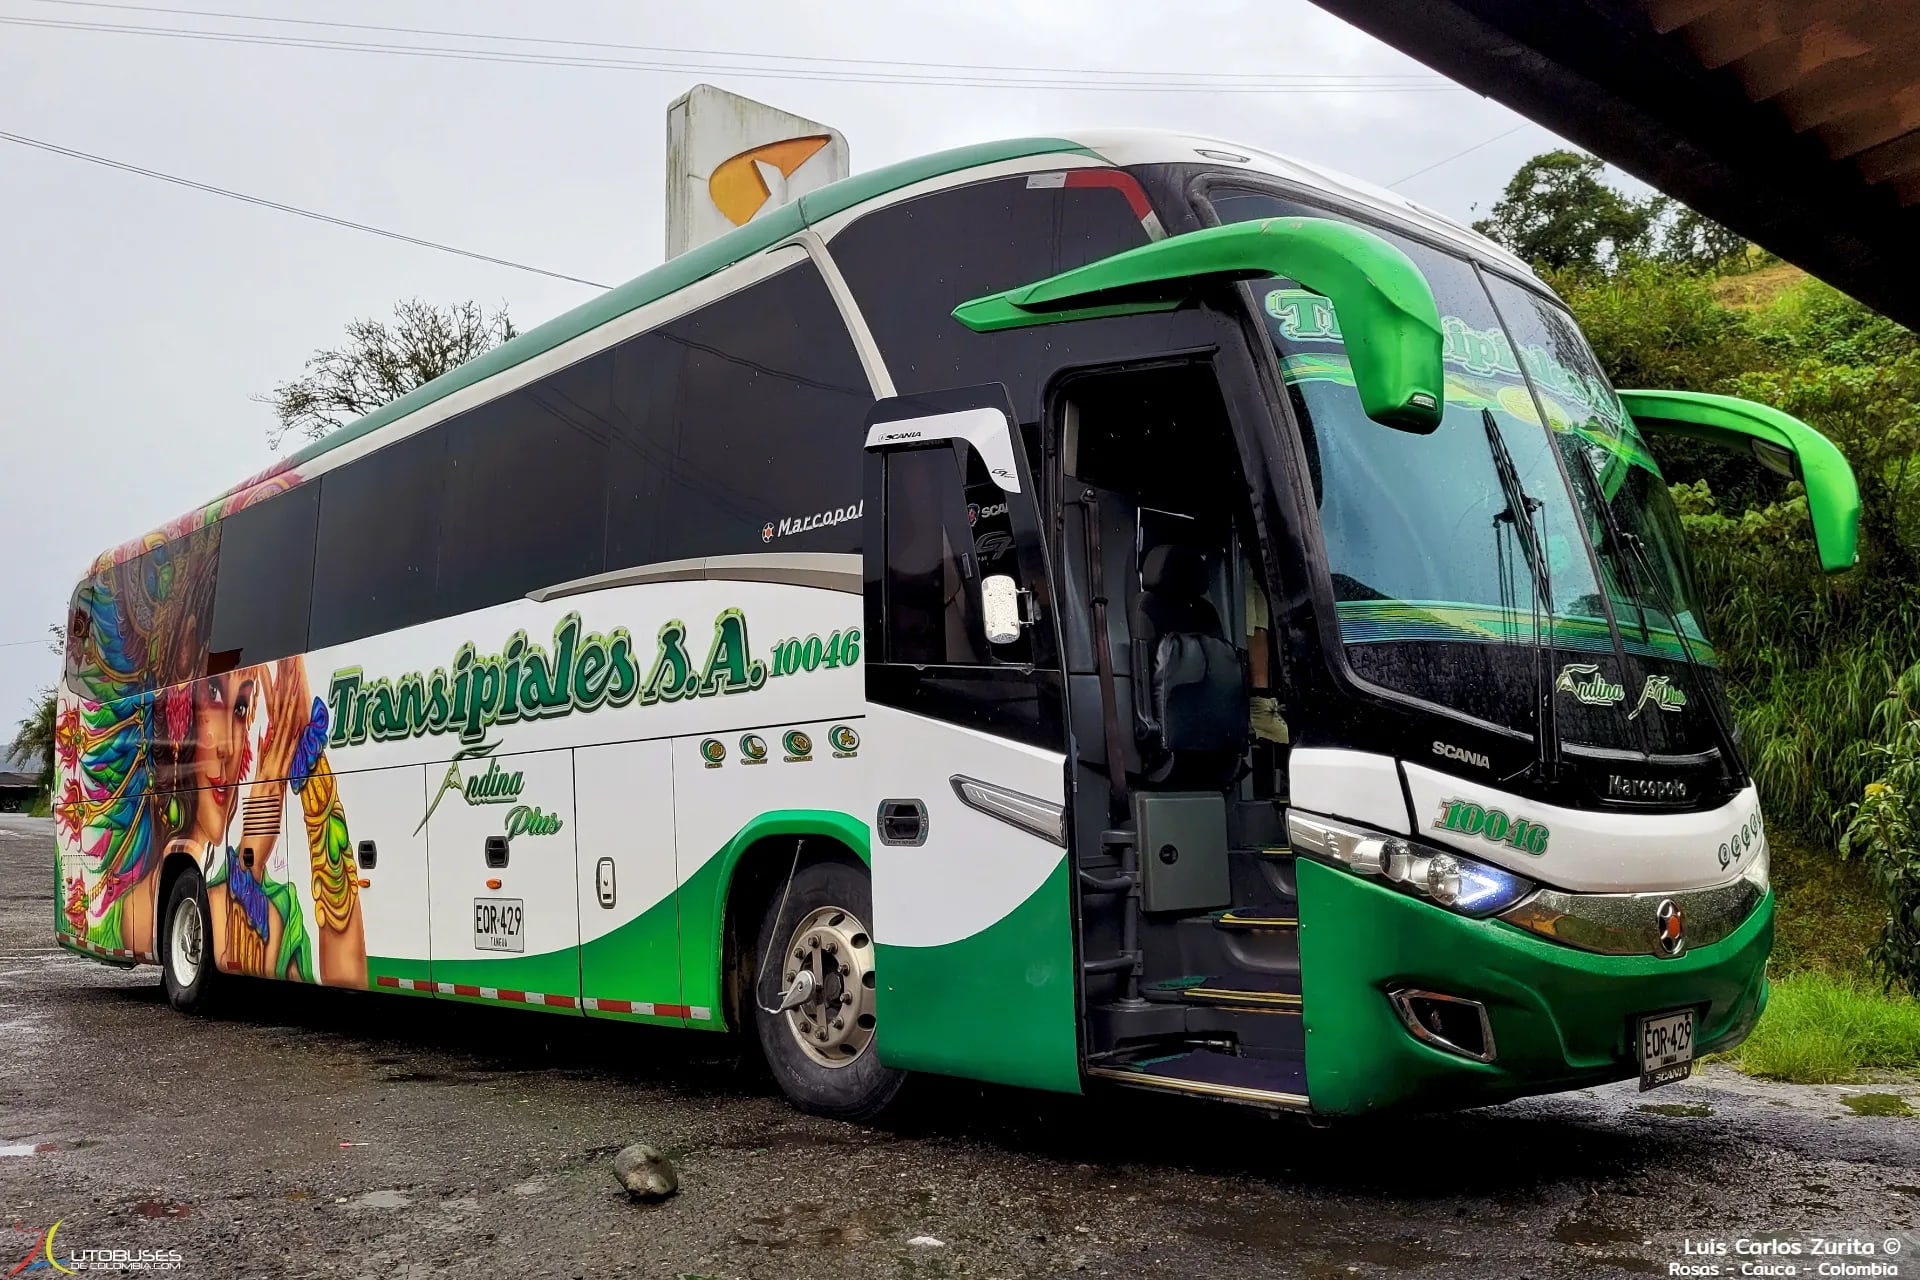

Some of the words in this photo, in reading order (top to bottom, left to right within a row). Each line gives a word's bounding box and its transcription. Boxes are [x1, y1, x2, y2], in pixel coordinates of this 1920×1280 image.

[885, 431, 922, 441] SCANIA
[777, 500, 864, 538] Marcopol
[981, 503, 1009, 518] SCA
[328, 610, 640, 749] Transipiales
[769, 627, 862, 678] 10046
[1432, 740, 1490, 769] SCANIA
[1608, 774, 1687, 799] Marcopolo
[504, 805, 564, 842] Plus
[1433, 796, 1551, 856] 10046
